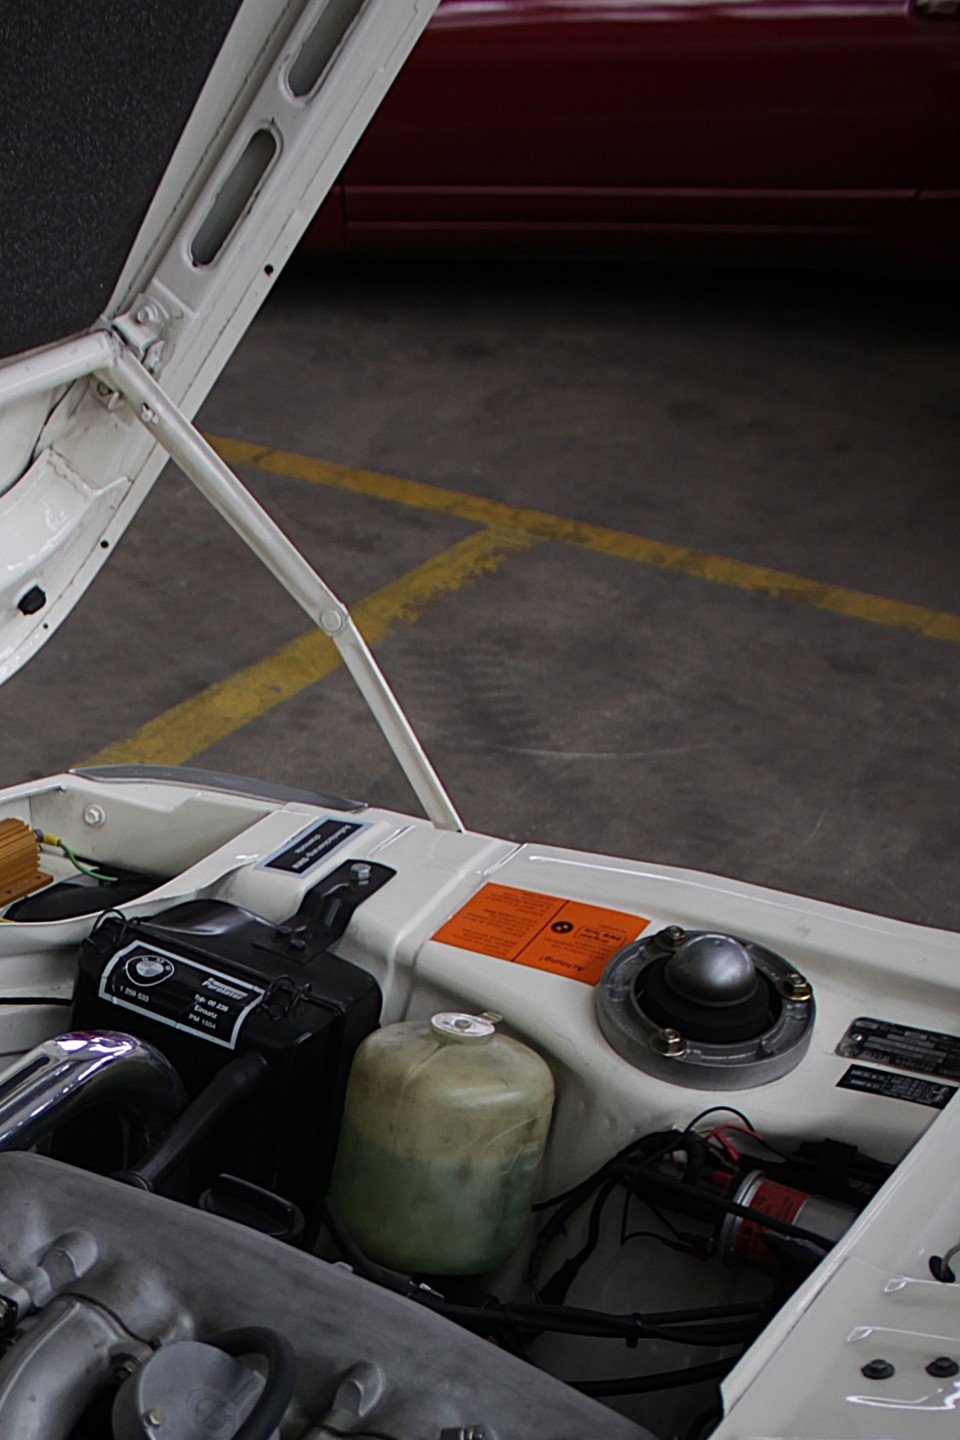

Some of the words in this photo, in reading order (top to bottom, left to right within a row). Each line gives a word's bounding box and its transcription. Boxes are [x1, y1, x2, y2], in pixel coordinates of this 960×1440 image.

[539, 956, 585, 972] Achtung!
[202, 977, 249, 1000] Purolator
[194, 1004, 218, 1019] Einsatz
